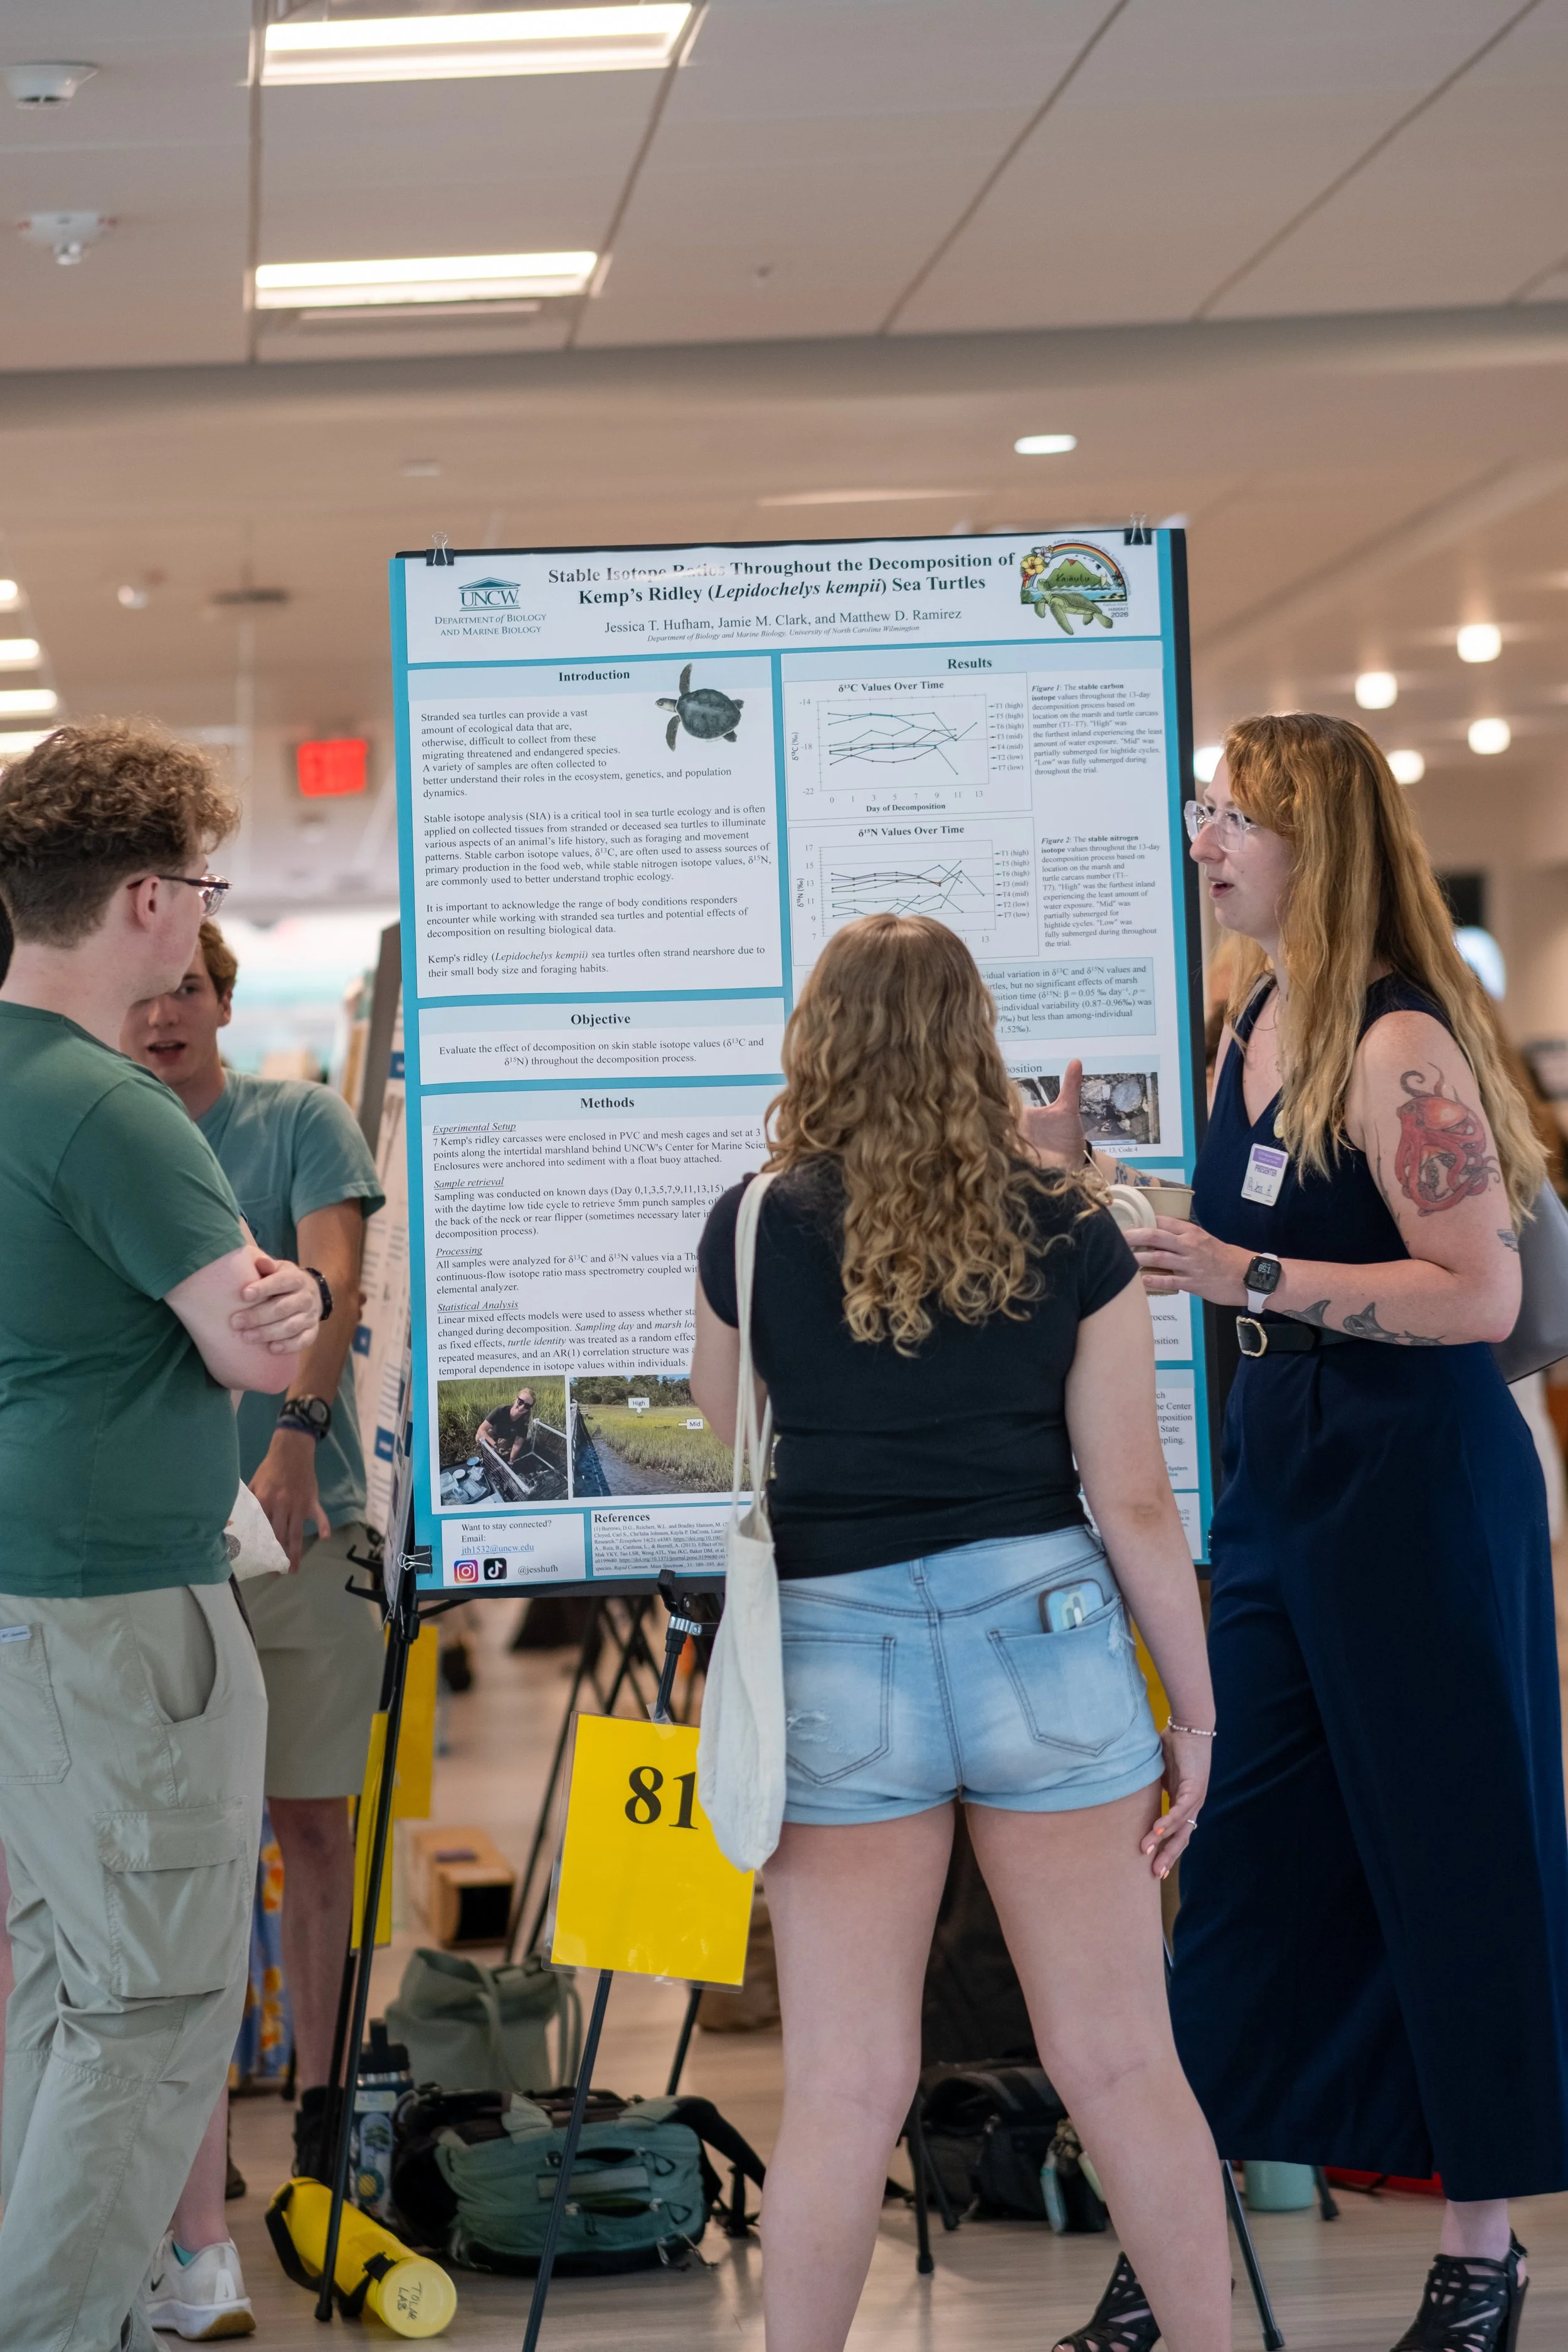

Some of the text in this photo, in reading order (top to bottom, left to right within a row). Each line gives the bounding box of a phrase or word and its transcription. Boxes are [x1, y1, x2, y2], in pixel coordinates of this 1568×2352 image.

[549, 568, 600, 583] Stable
[607, 567, 666, 582] Isotope
[730, 560, 831, 577] Throughout
[837, 559, 862, 571] the
[869, 554, 992, 572] Decomposition
[998, 552, 1015, 566] of
[579, 576, 985, 607] Kemp’s Ridley (Lepidochelys kempii) Sea Turtles
[460, 590, 519, 607] UNCW
[434, 613, 546, 624] DEPARTMENT of BIOLOGY
[605, 608, 961, 633] Jessica T. Hufham, Jamie M. Clark, and Matthew D. Ramirez
[462, 627, 499, 635] MARINE
[501, 626, 541, 634] BIOLOGY
[647, 635, 686, 643] Department
[696, 632, 719, 640] Biology
[823, 627, 832, 635] of
[948, 657, 992, 669] Results
[559, 670, 630, 681] Introduction
[861, 683, 891, 691] Values
[894, 682, 918, 690] Over
[919, 681, 944, 689] Time
[1031, 685, 1054, 693] Figure
[1031, 694, 1056, 702] isotope
[1079, 692, 1115, 701] throughout
[1004, 702, 1024, 711] (high)
[421, 712, 459, 721] Stranded
[479, 711, 506, 719] turtles
[527, 709, 559, 720] provide
[422, 745, 620, 761] migrating threatened and endangered species.
[424, 813, 450, 823] Stable
[454, 813, 485, 823] isotope
[487, 812, 523, 822] analysis
[526, 812, 551, 822] (SIA)
[554, 811, 561, 820] is
[571, 810, 601, 819] critical
[604, 809, 620, 818] tool
[624, 809, 632, 817] in
[652, 808, 674, 817] turtle
[677, 807, 711, 817] ecology
[714, 805, 730, 814] and
[733, 805, 740, 813] is
[743, 804, 765, 813] often
[892, 803, 945, 812] Decomposition
[881, 827, 911, 835] Values
[914, 826, 938, 835] Over
[940, 825, 964, 834] Time
[571, 1014, 630, 1027] Objective
[439, 1046, 476, 1054] Evaluate
[479, 1044, 492, 1052] the
[494, 1044, 519, 1052] effect
[521, 1043, 531, 1051] of
[532, 1042, 595, 1052] decomposition
[612, 1041, 629, 1049] skin
[632, 1041, 657, 1049] stable
[660, 1041, 690, 1050] isotope
[693, 1039, 720, 1047] values
[748, 1037, 763, 1046] and
[531, 1056, 578, 1066] throughout
[581, 1056, 593, 1064] the
[596, 1054, 659, 1065] decomposition
[662, 1056, 696, 1064] process.
[581, 1097, 634, 1108] Methods
[433, 1122, 516, 1135] Experimental Setup
[433, 1177, 504, 1190] Sample retrieval
[435, 1246, 483, 1258] Processing
[1258, 1264, 1271, 1274] 1:59
[438, 1300, 519, 1314] Statistical Analysis
[509, 1519, 551, 1528] connected?
[594, 1513, 650, 1523] References
[462, 1534, 485, 1542] Email:
[461, 1542, 535, 1555] jth1532@uncw.edu
[517, 1564, 558, 1576] @jesshufh
[625, 1766, 698, 1830] 81
[397, 2287, 409, 2311] LAB
